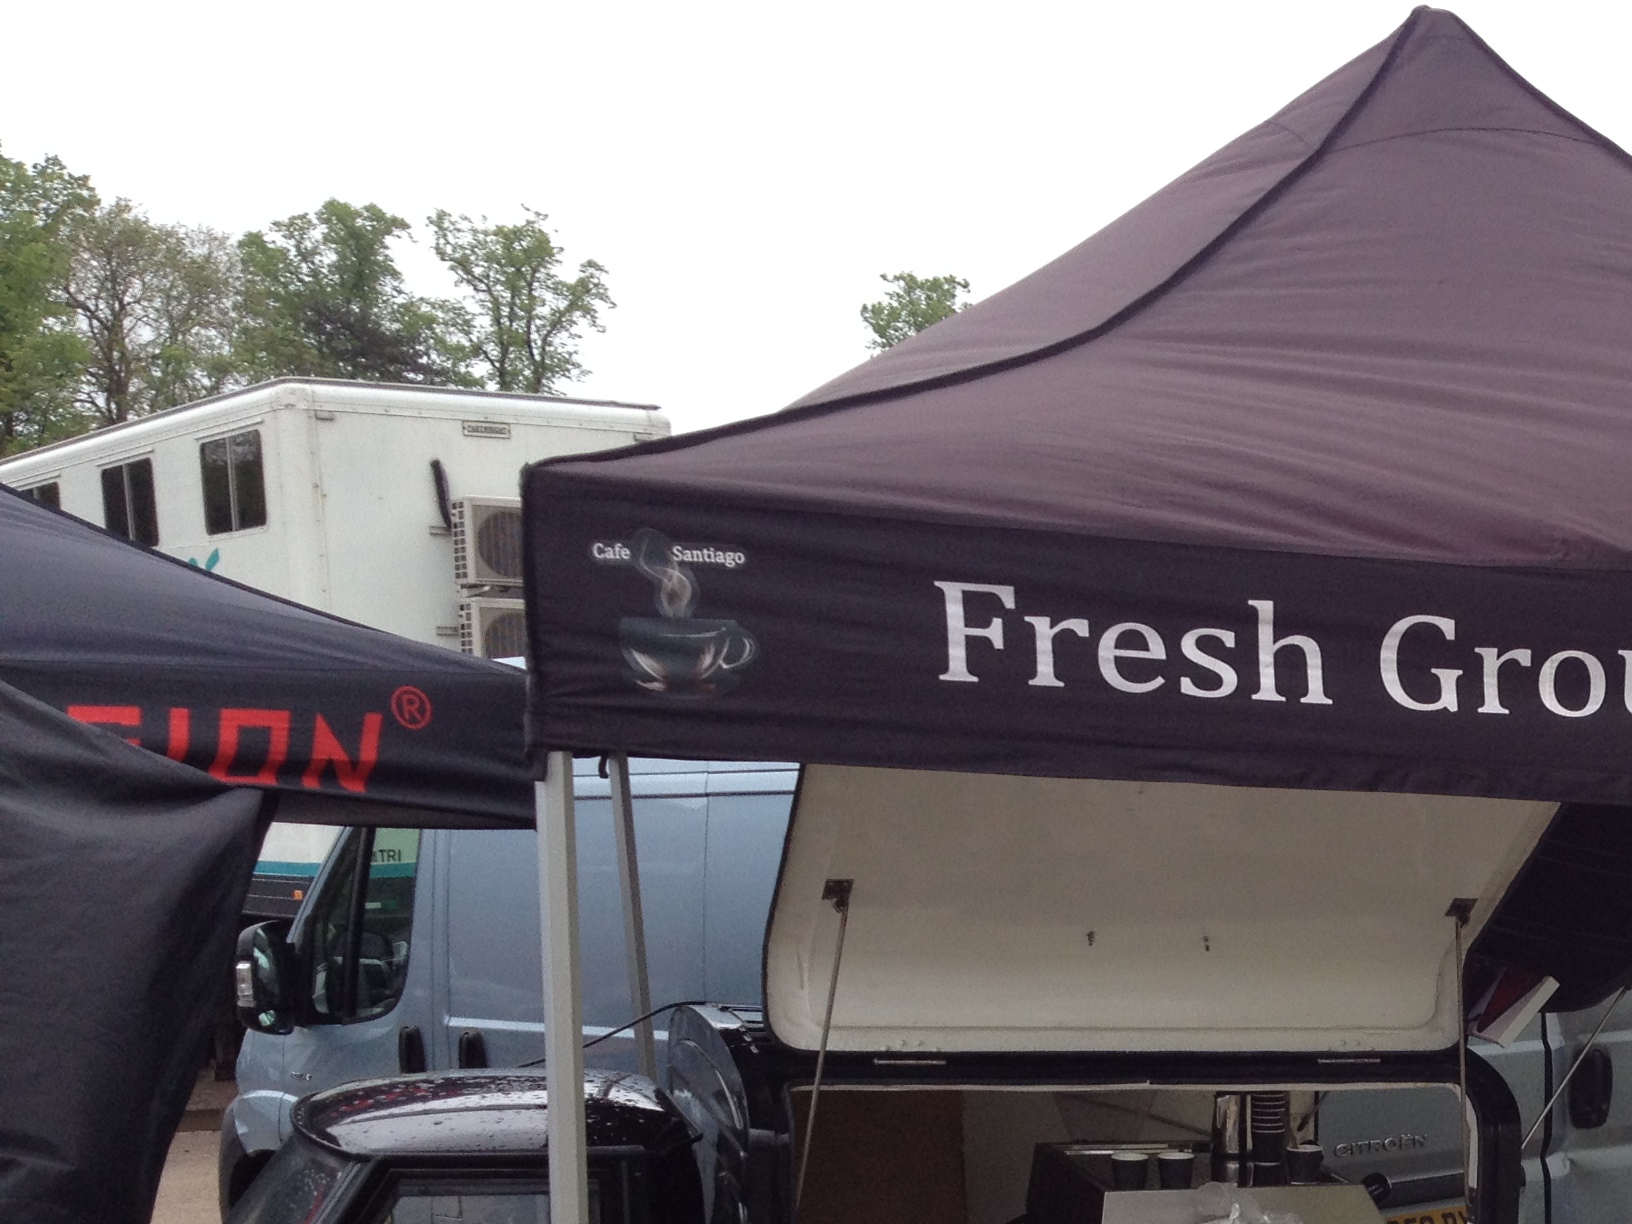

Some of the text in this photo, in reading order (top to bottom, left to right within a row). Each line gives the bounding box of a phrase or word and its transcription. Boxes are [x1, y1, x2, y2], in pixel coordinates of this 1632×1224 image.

[592, 542, 746, 568] Cafe Santiago
[933, 580, 1334, 705] Fresh
